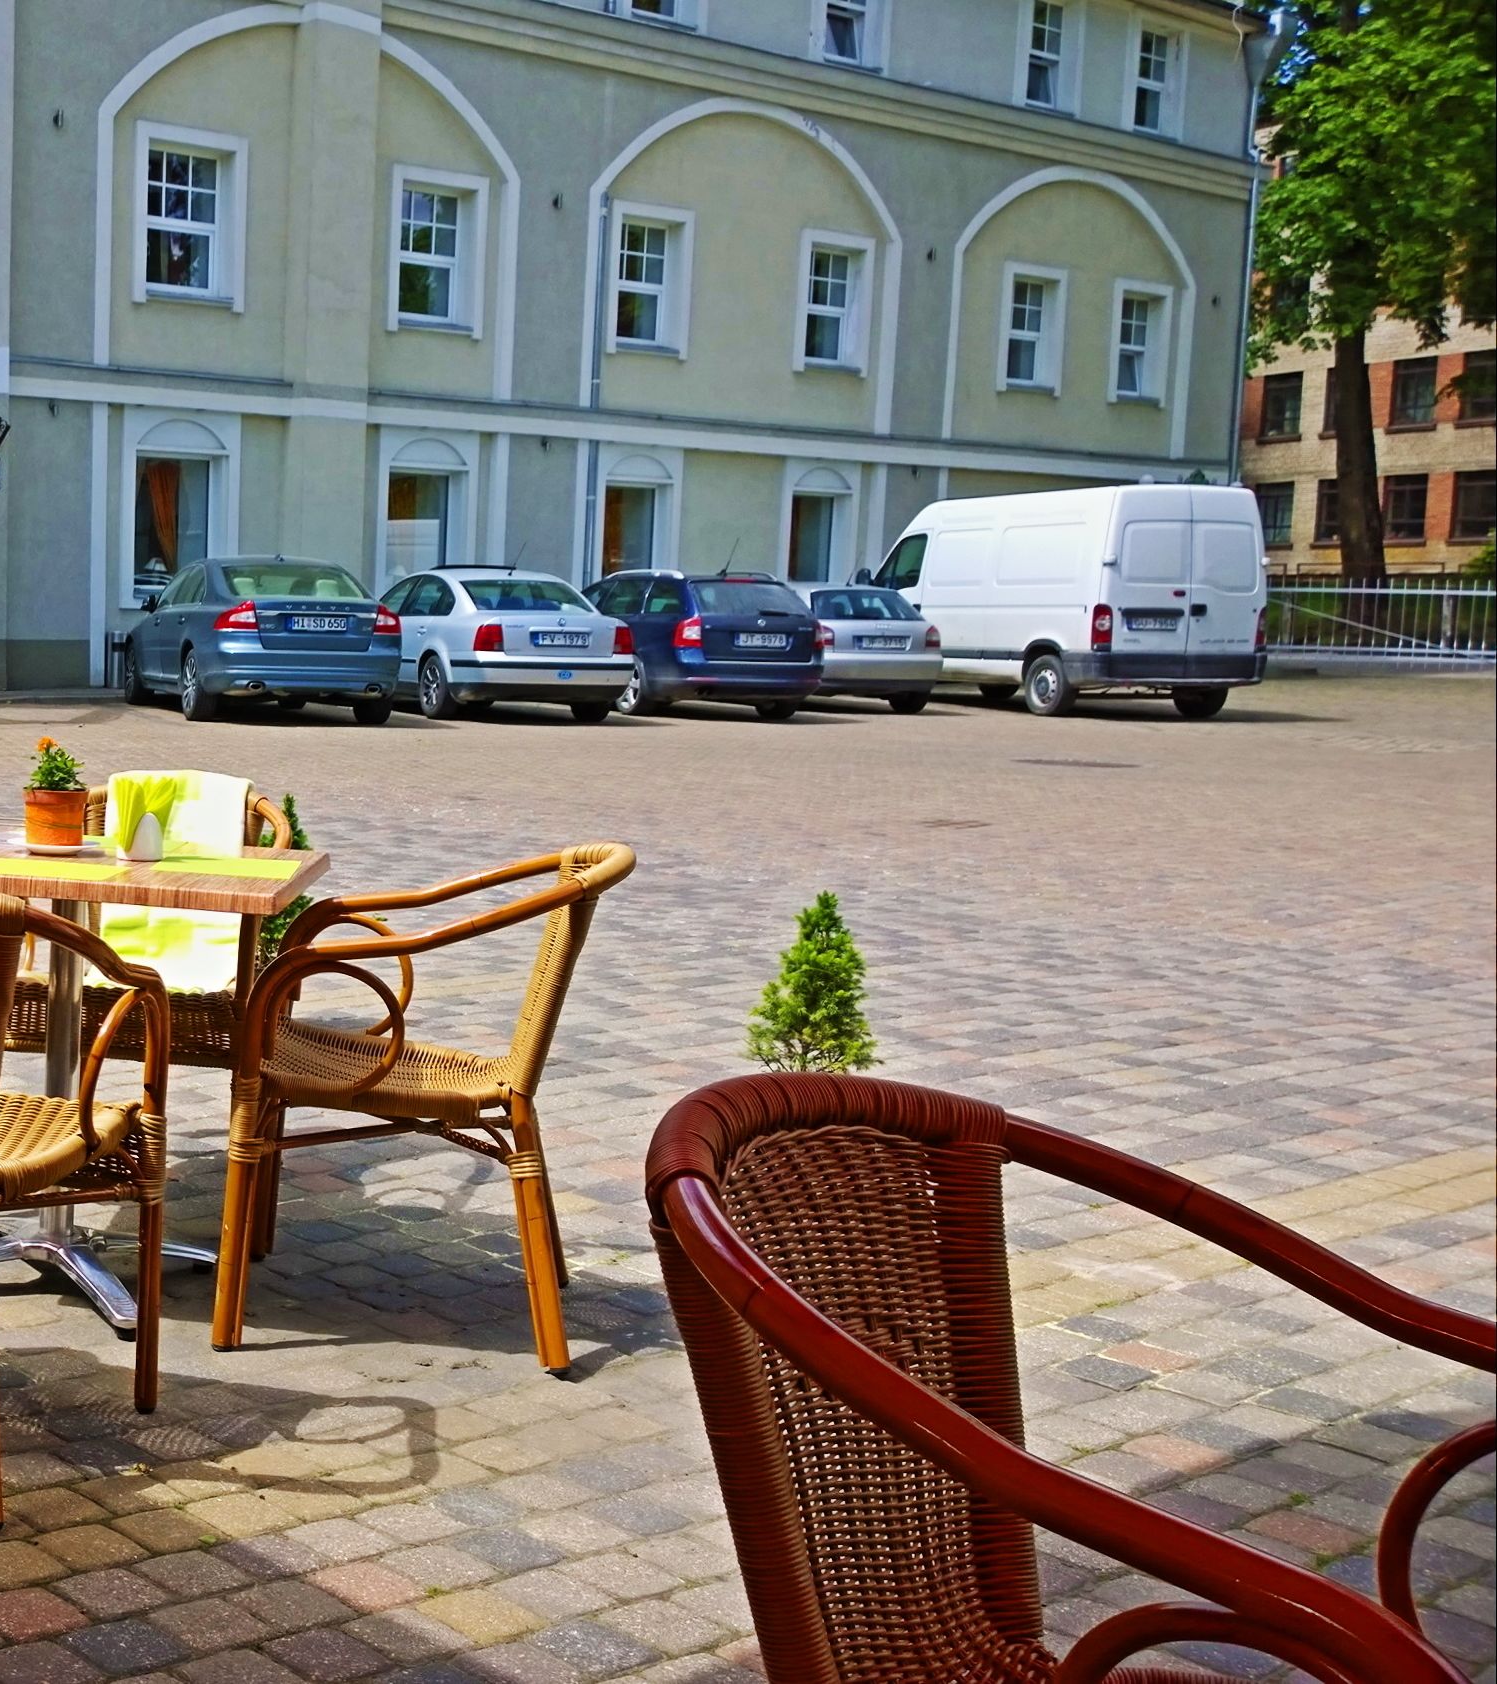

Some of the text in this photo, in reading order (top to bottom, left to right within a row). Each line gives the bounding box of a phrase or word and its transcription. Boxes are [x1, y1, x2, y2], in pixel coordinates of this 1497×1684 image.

[293, 618, 346, 630] HI SD 650
[541, 634, 588, 645] FV-1979
[742, 634, 784, 646] JT-9978
